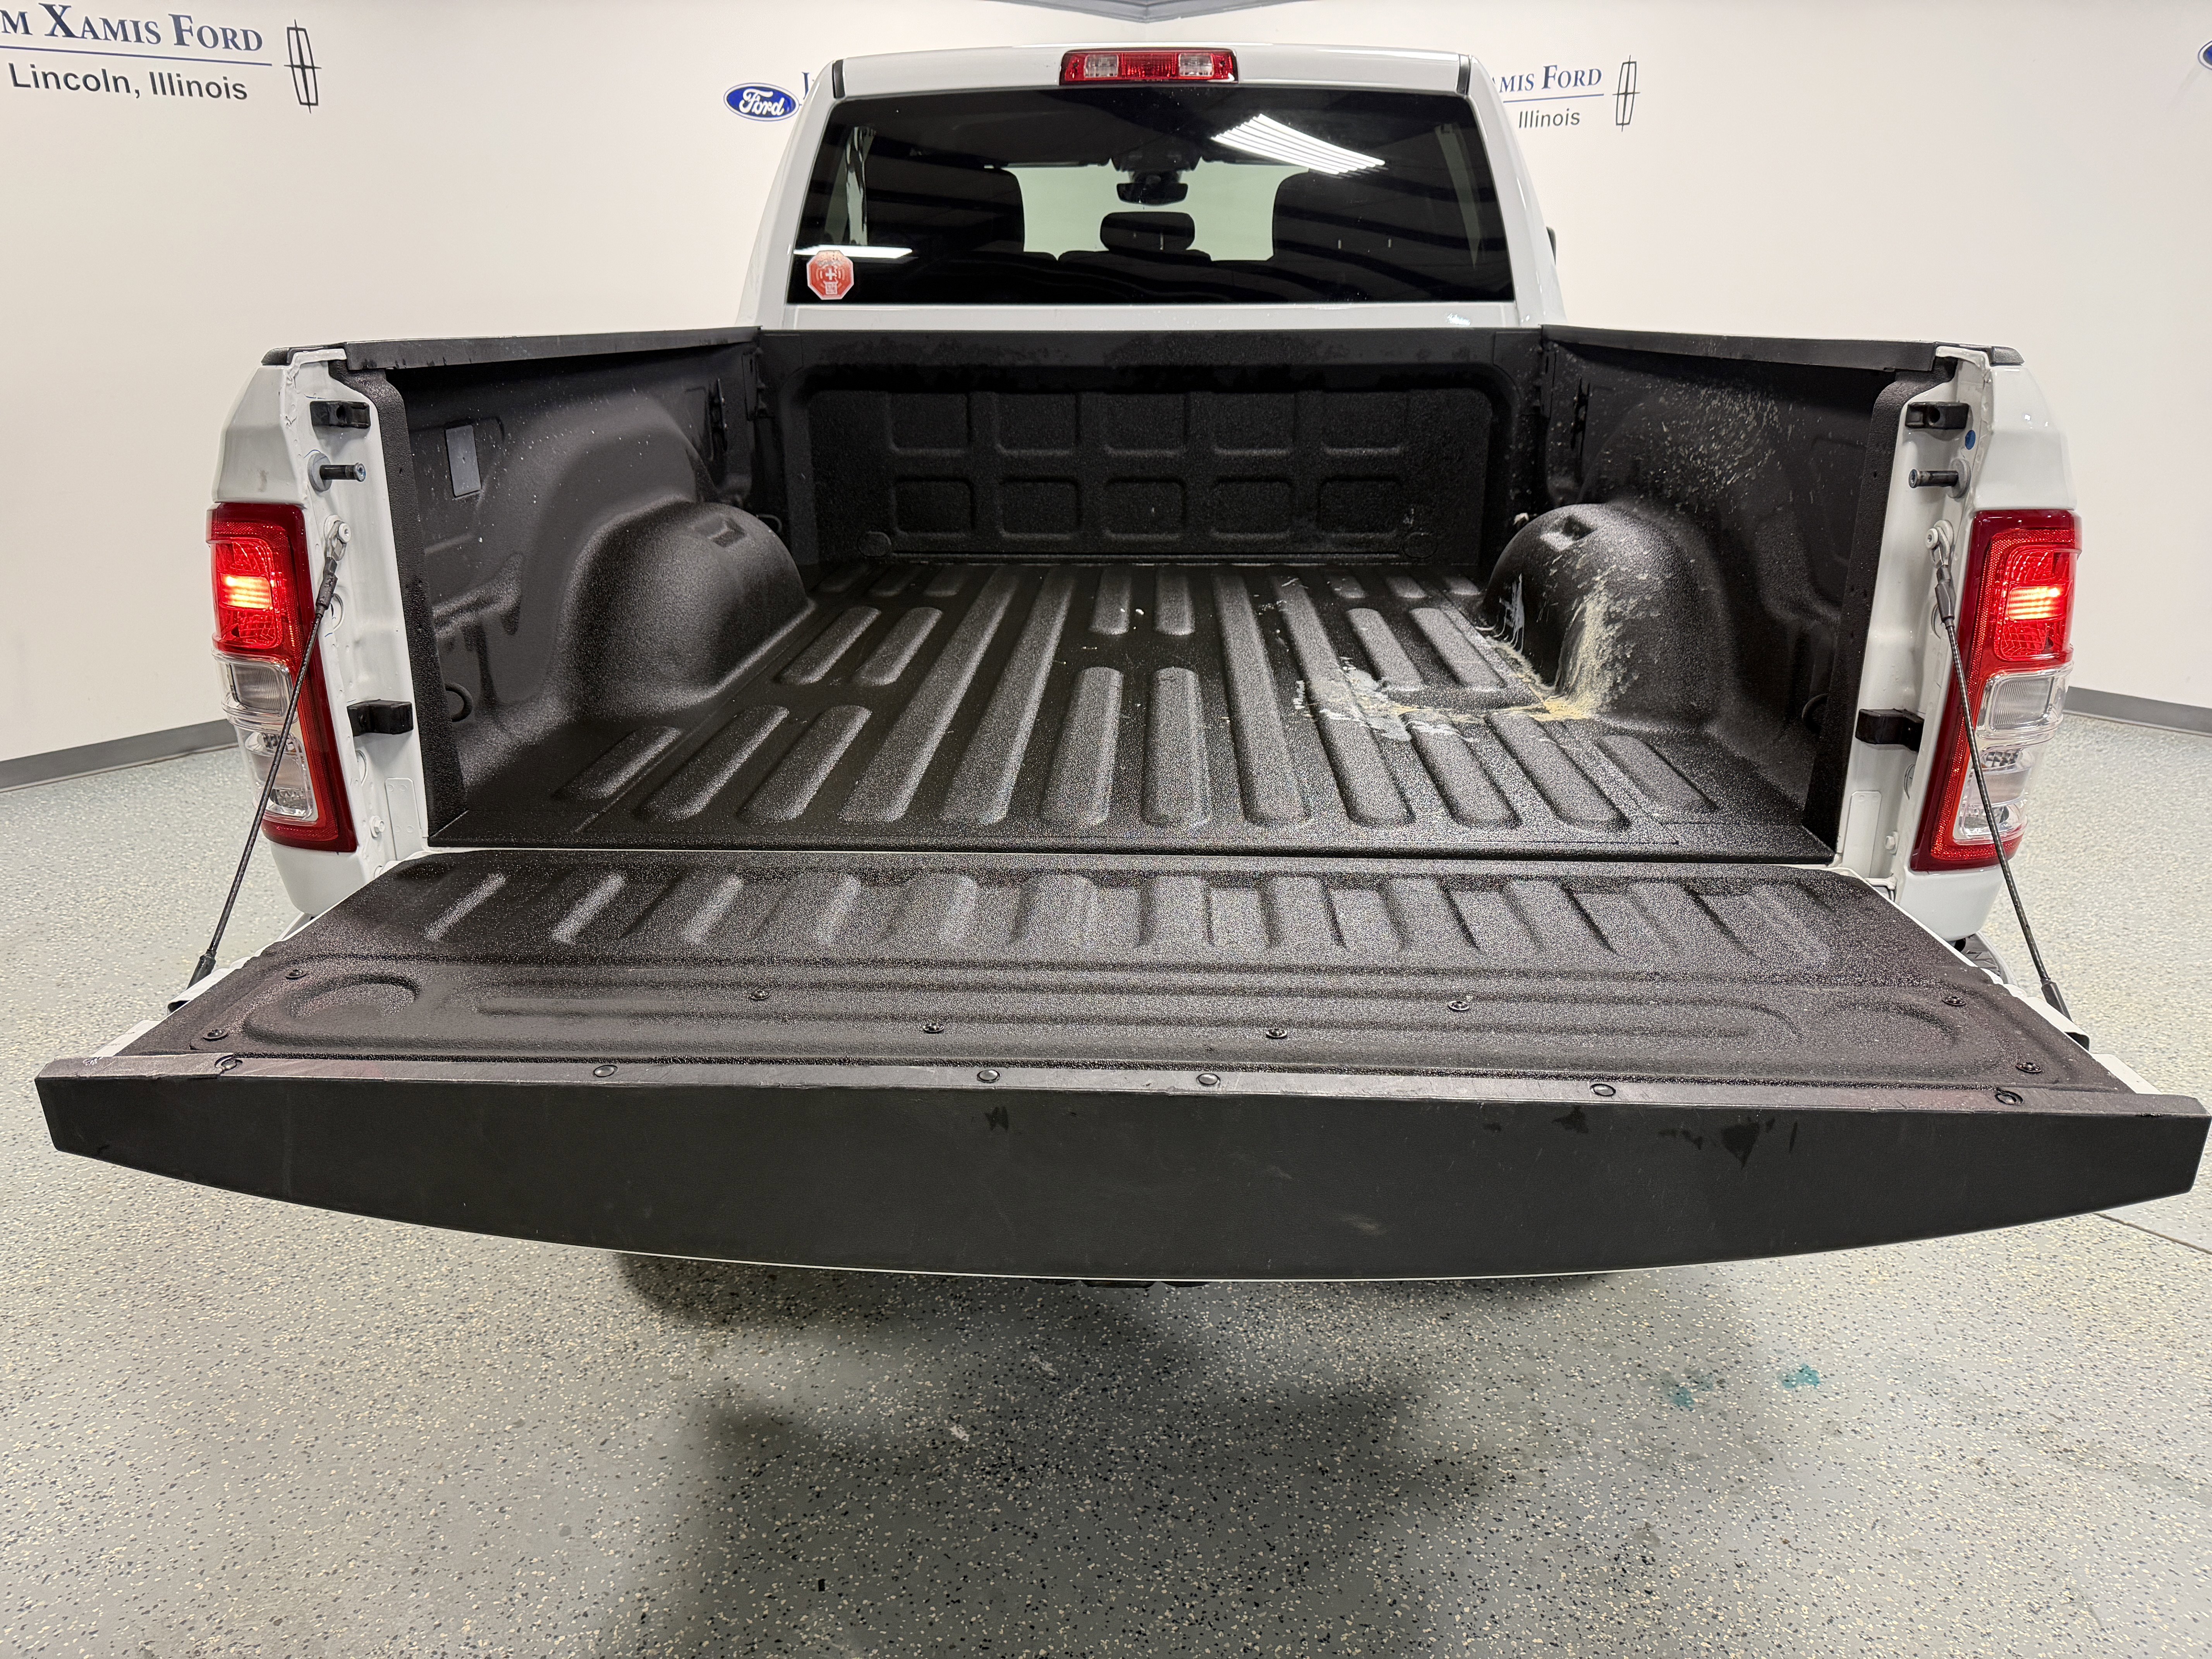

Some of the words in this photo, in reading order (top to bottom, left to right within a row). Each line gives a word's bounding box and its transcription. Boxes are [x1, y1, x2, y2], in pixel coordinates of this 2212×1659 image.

[39, 3, 161, 45] XAMIS
[168, 14, 263, 52] FORD
[9, 63, 140, 99] Lincoln,
[149, 72, 248, 100] Illinois
[1492, 73, 1534, 93] MIS
[1541, 65, 1602, 89] FORD
[739, 89, 785, 115] Ford
[1519, 108, 1580, 128] Illinois
